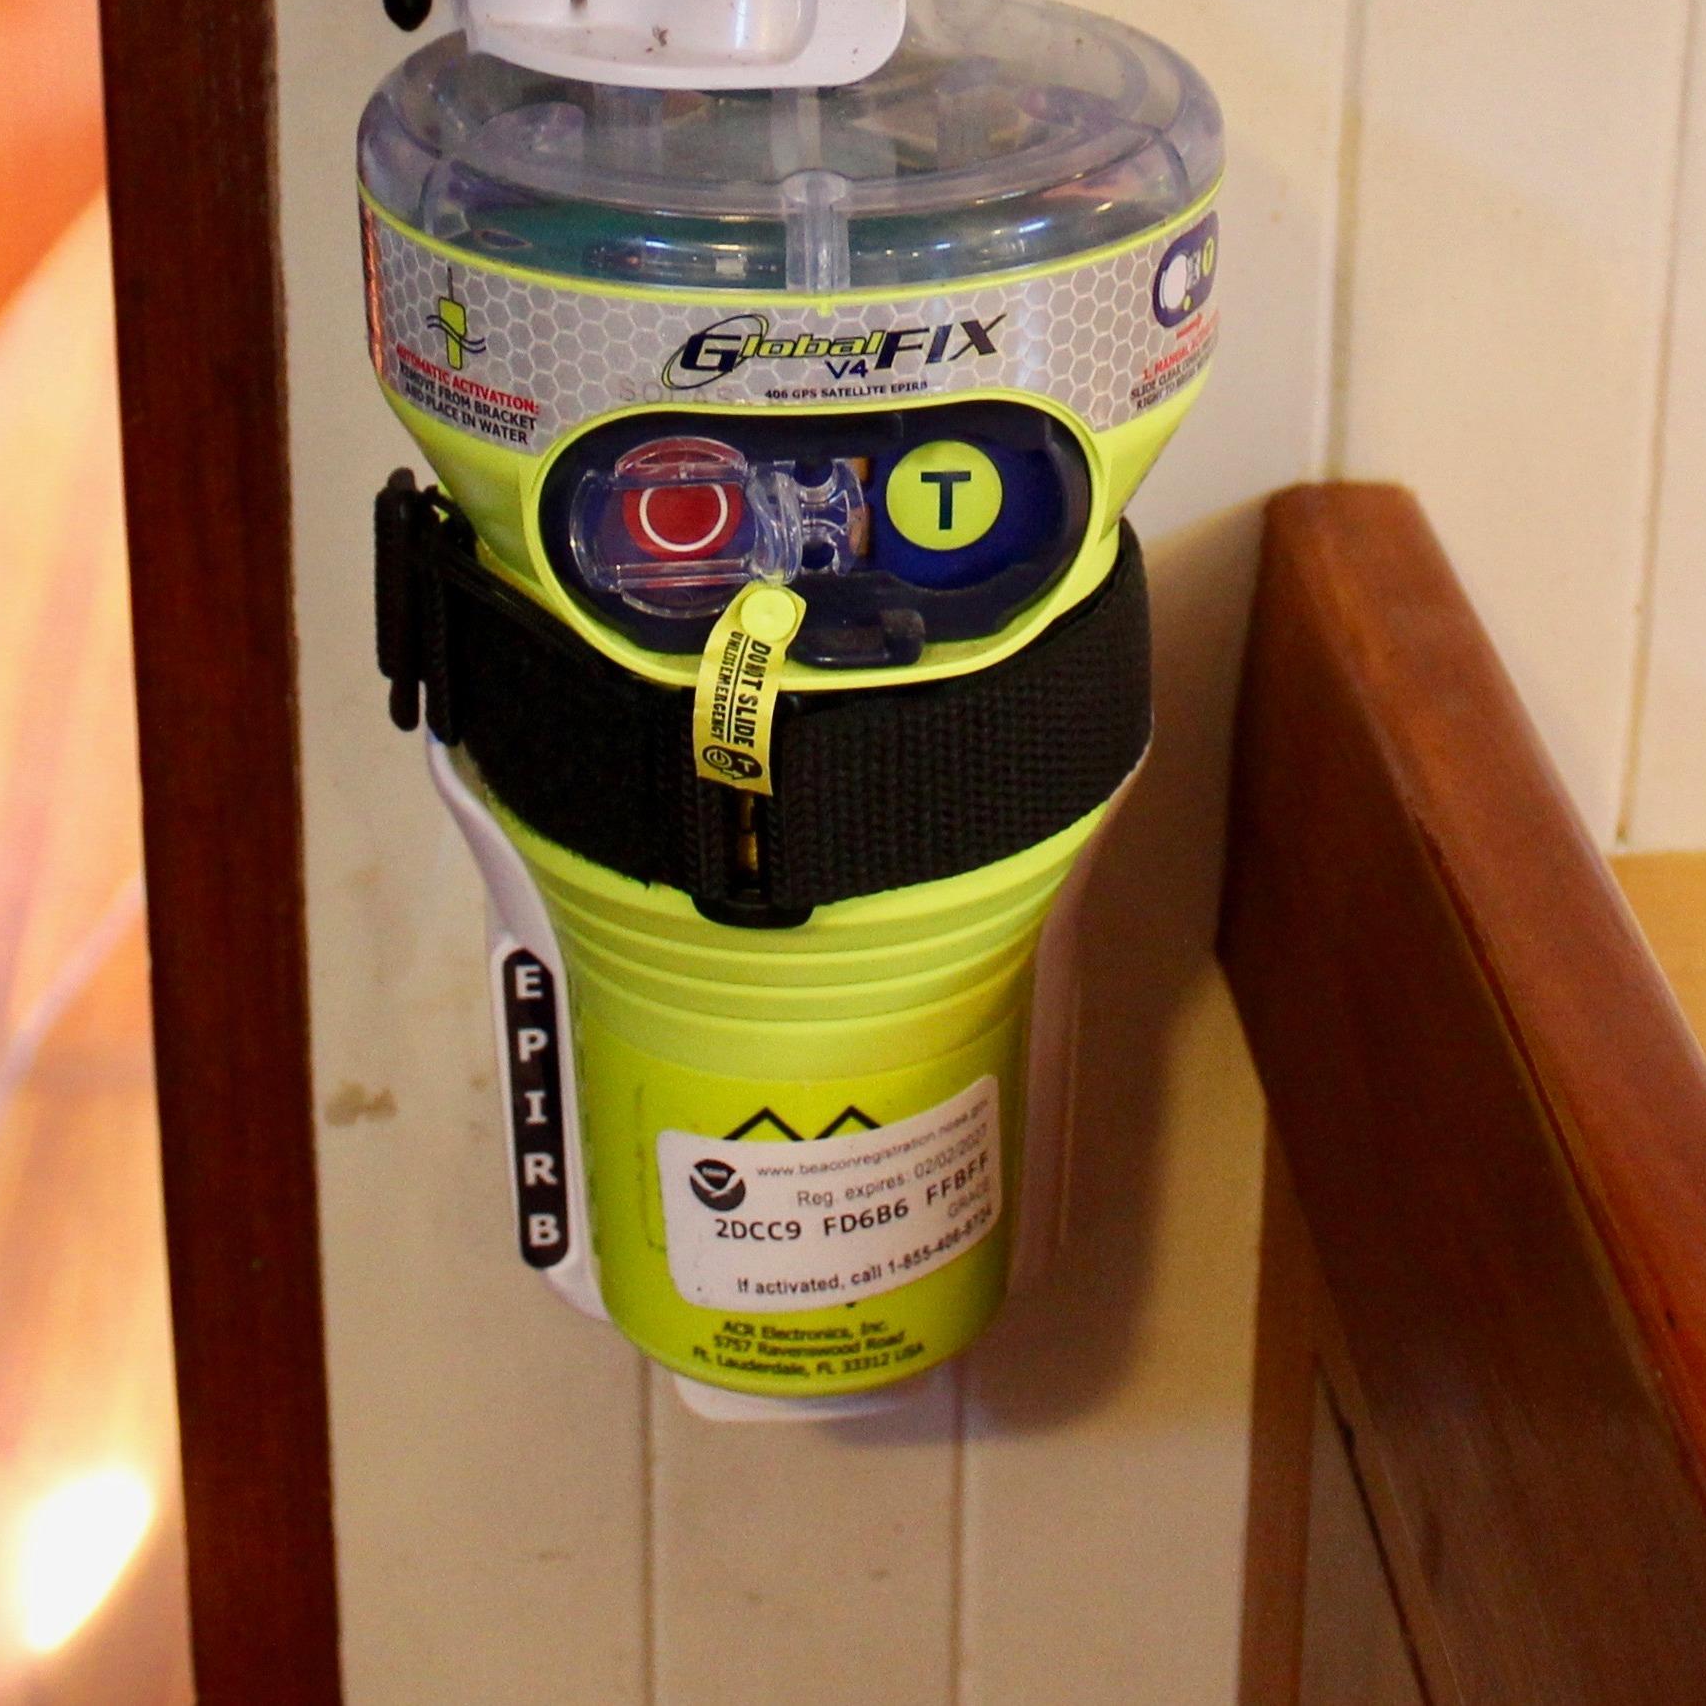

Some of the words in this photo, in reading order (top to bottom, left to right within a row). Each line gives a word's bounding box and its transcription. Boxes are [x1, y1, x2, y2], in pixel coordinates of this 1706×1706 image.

[452, 376, 541, 415] ACTIVATION:
[764, 389, 789, 399] 406
[792, 387, 818, 399] GPS
[821, 385, 888, 398] SATELLITE
[890, 381, 929, 395] EPIRB
[824, 359, 869, 381] V4
[425, 392, 459, 422] PLACE
[461, 411, 477, 428] IN
[479, 417, 529, 445] WATER
[437, 379, 472, 410] FROM
[474, 395, 537, 431] BRACKET
[920, 470, 972, 531] T
[710, 666, 734, 742] EMERGENCY
[734, 693, 758, 748] SLIDE
[514, 964, 560, 1247] EPIRB
[715, 1218, 803, 1242] 2DCC9
[823, 1198, 910, 1237] FD6B6
[924, 1150, 991, 1206] FFBFF
[737, 1278, 749, 1294] If
[755, 1275, 845, 1295] activated,
[851, 1265, 882, 1287] call
